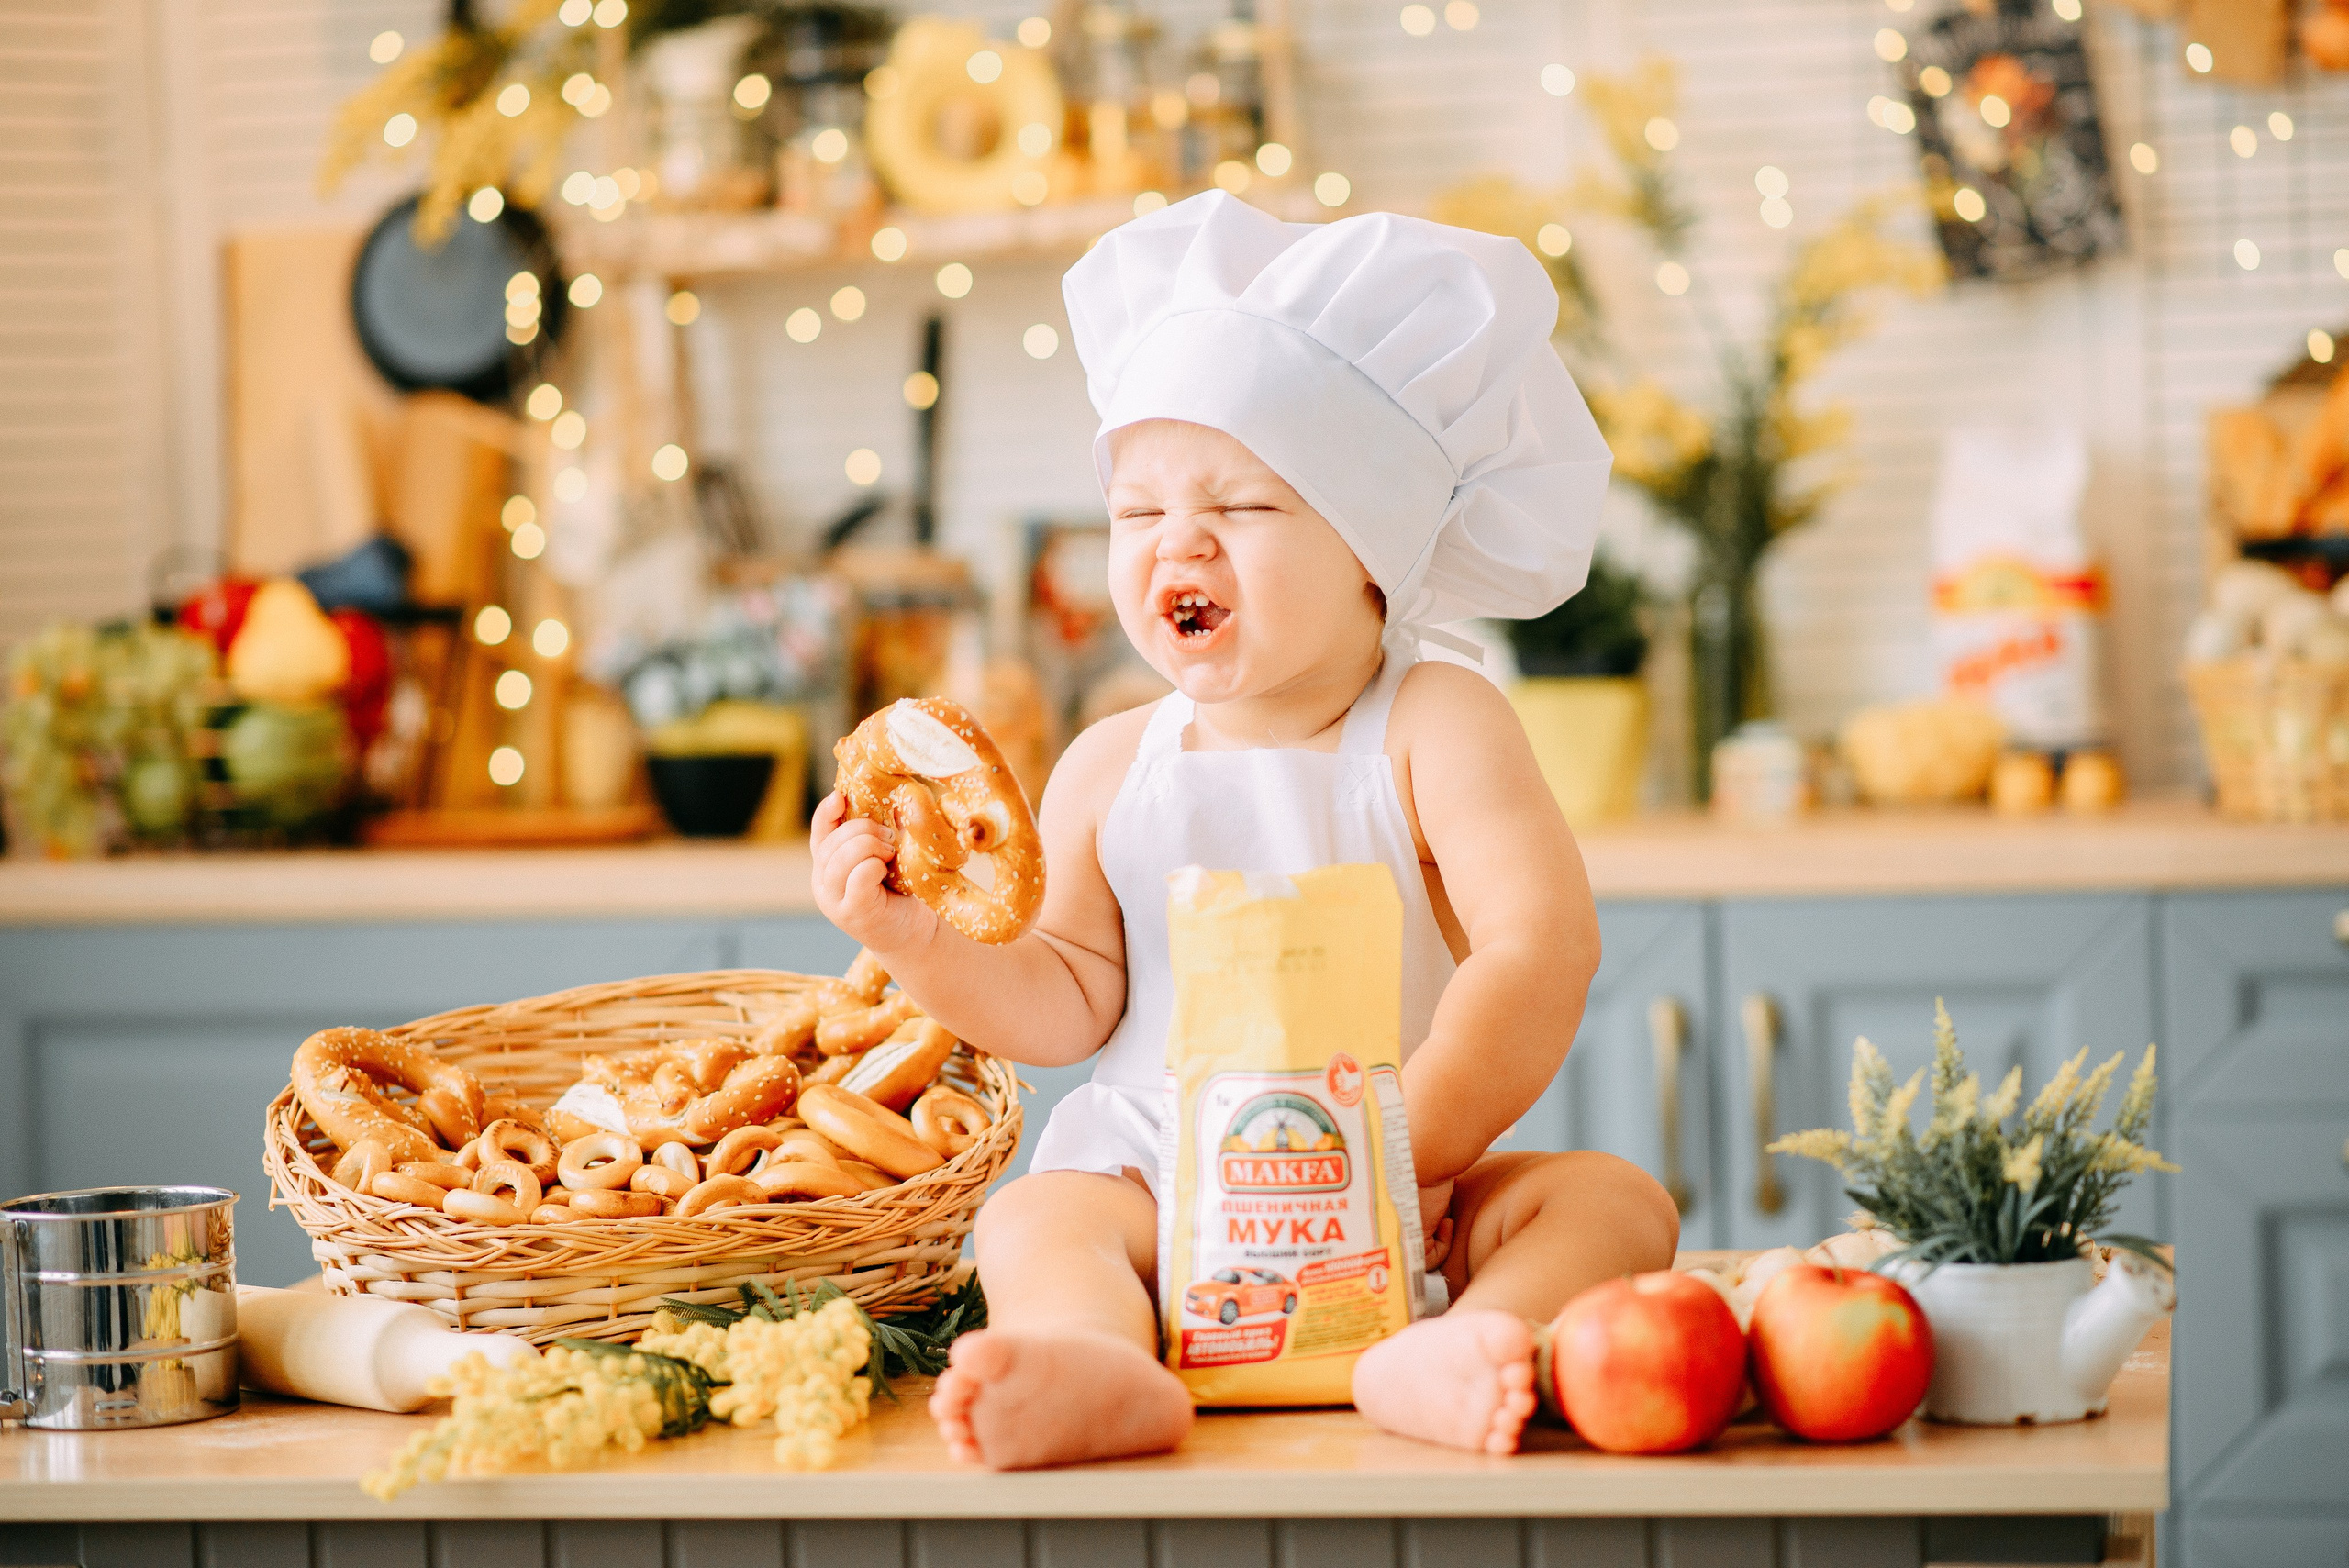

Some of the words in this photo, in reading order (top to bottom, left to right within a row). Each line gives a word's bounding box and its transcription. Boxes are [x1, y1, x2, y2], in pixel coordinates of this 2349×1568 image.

[1229, 1160, 1338, 1183] MAKFA
[1221, 1198, 1348, 1213] ПШЕНИЧНАЯ
[1228, 1217, 1346, 1245] МУКА
